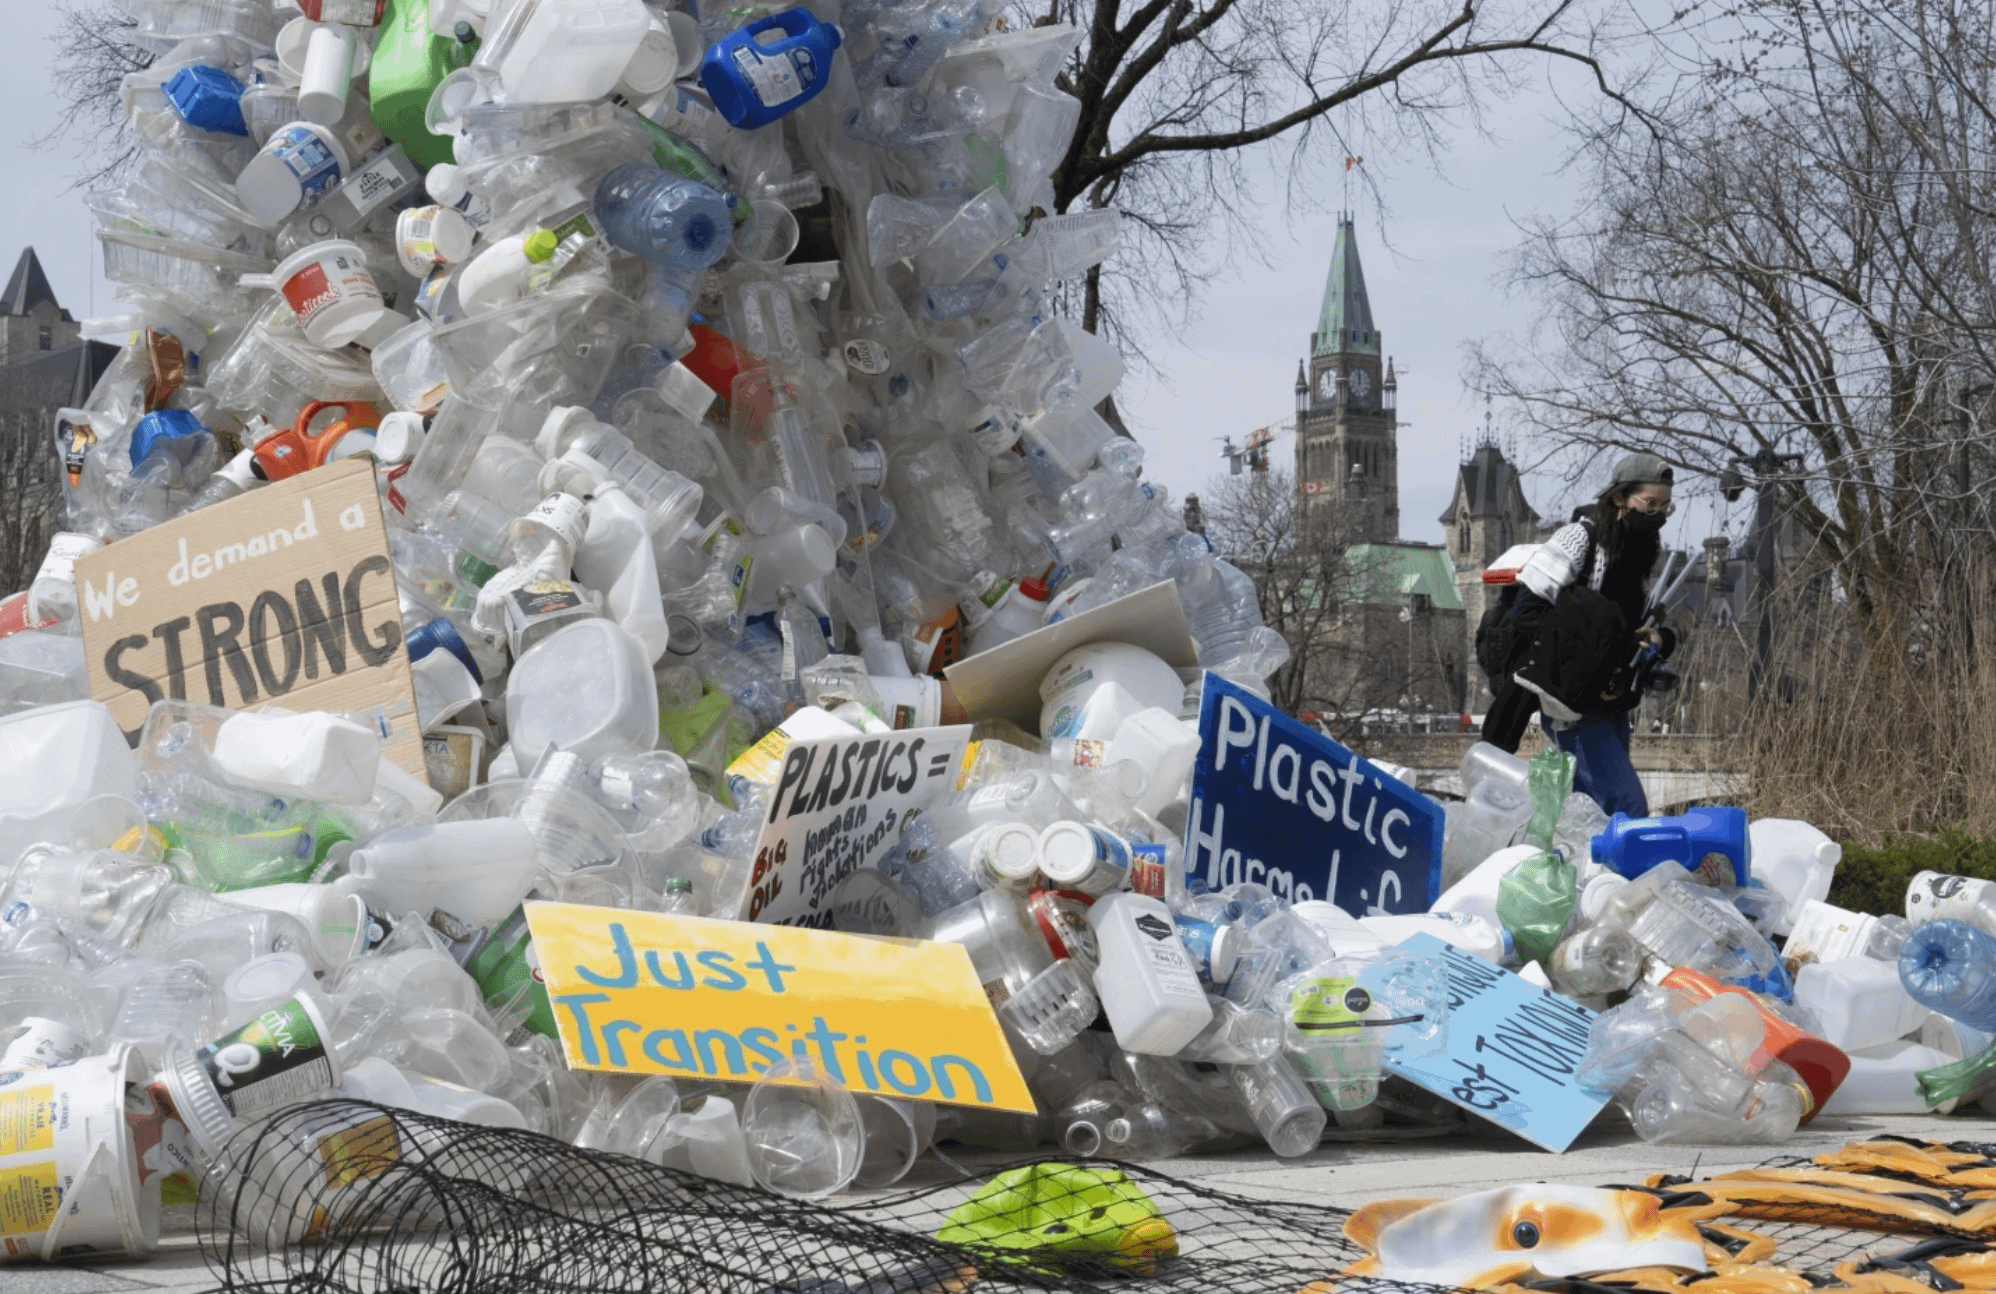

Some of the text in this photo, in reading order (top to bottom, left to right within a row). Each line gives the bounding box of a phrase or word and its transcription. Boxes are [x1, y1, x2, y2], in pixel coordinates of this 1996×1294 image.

[84, 499, 366, 622] We demand a
[104, 555, 402, 750] STRONG
[769, 737, 926, 824] PLASTICS
[1215, 695, 1411, 858] Plastic
[749, 872, 784, 923] OIL
[751, 838, 788, 888] BIG
[575, 922, 797, 993] Just
[553, 993, 994, 1103] Transition
[42, 1186, 55, 1213] REAL
